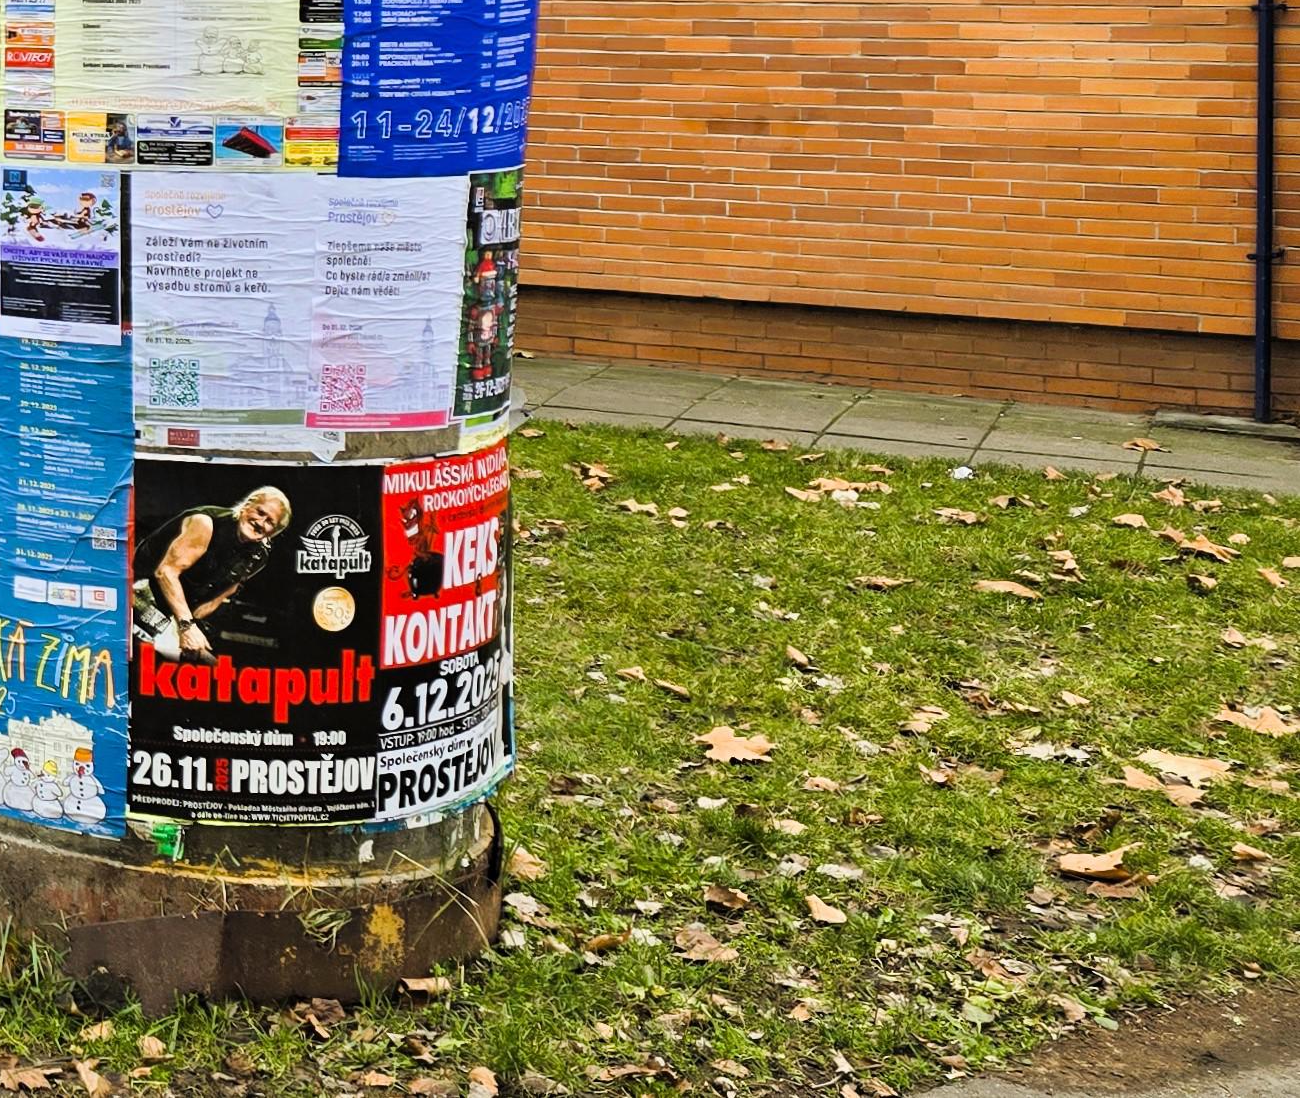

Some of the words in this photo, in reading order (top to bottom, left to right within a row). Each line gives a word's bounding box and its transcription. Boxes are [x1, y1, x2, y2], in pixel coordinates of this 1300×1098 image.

[144, 203, 201, 219] Prostějov
[327, 210, 377, 226] Prostějov
[145, 235, 179, 247] Záleží
[180, 236, 204, 248] Vám
[206, 239, 221, 248] na
[223, 237, 268, 249] životním
[146, 251, 202, 263] prostředí?
[326, 254, 372, 267] společně!
[146, 265, 201, 278] Navrhněte
[204, 266, 243, 280] projekt
[245, 269, 258, 279] na
[325, 270, 338, 281] Co
[339, 269, 366, 283] byste
[146, 281, 191, 293] výsadbu
[193, 281, 232, 293] stromů
[234, 284, 241, 292] a
[244, 282, 271, 293] keřů.
[324, 285, 349, 298] Dejte
[351, 287, 371, 296] nám
[383, 456, 475, 495] MIKULÁŠSKÁ
[443, 515, 500, 590] KEKS
[296, 549, 373, 580] katapult
[383, 588, 498, 667] KONTAKT
[439, 651, 480, 677] SOBOTA
[138, 643, 376, 724] katapult
[381, 649, 501, 731] 6.12.2025
[172, 725, 261, 747] Společenský
[263, 729, 294, 747] dům
[312, 730, 347, 746] 19:00
[438, 723, 455, 737] hod
[379, 742, 445, 771] Společenský
[132, 750, 214, 792] 26.11.
[213, 757, 230, 792] 2025
[231, 752, 376, 796] PROSTĚJOV
[377, 728, 498, 813] PROSTĚJOV
[131, 794, 183, 808] PŘEDPRODEJ:
[183, 800, 224, 811] PROSTĚJOV
